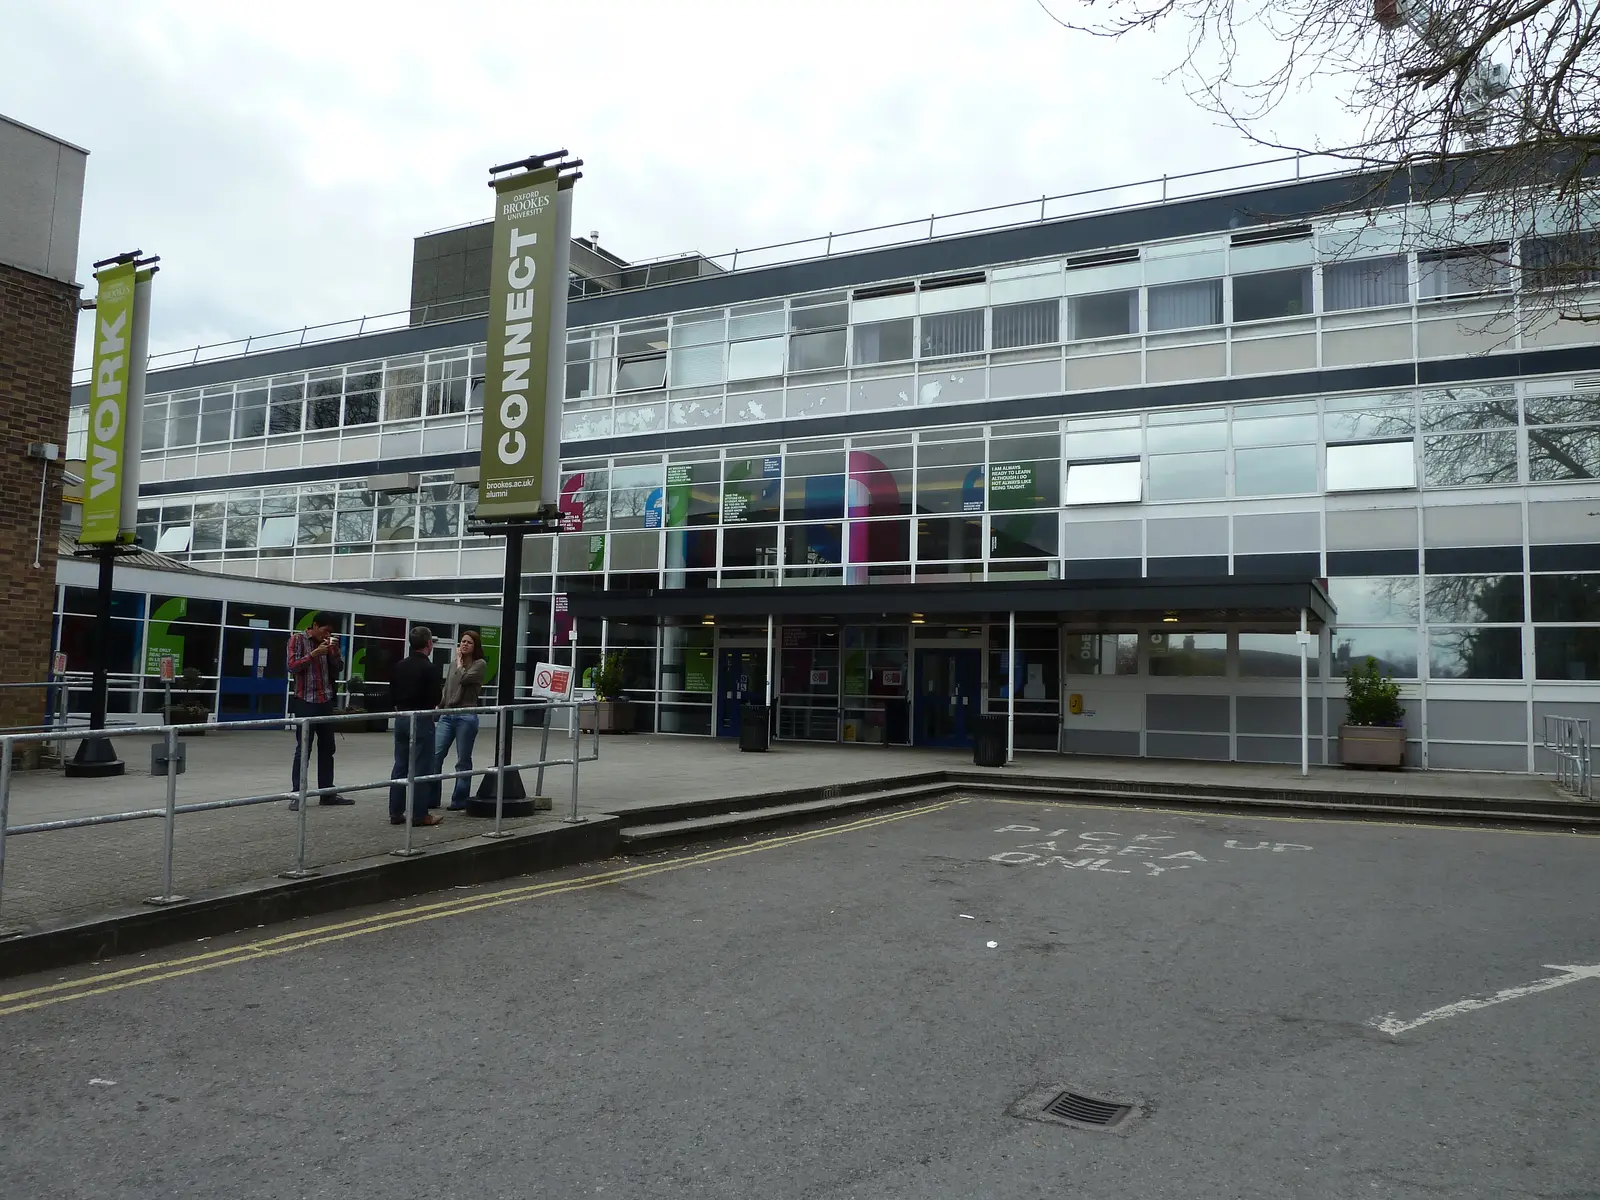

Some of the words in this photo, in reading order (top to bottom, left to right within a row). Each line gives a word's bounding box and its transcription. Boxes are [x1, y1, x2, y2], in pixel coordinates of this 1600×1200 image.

[514, 190, 539, 202] OXFORD
[503, 195, 550, 215] BROOKES
[508, 208, 544, 220] UNIVERSITY
[498, 228, 538, 465] CONNECT
[90, 308, 126, 500] WORK
[486, 478, 534, 489] brookes.ac.uk/
[486, 490, 508, 498] alumni
[1018, 840, 1208, 862] AREA
[1224, 839, 1314, 853] UP
[988, 851, 1191, 876] ONLY
